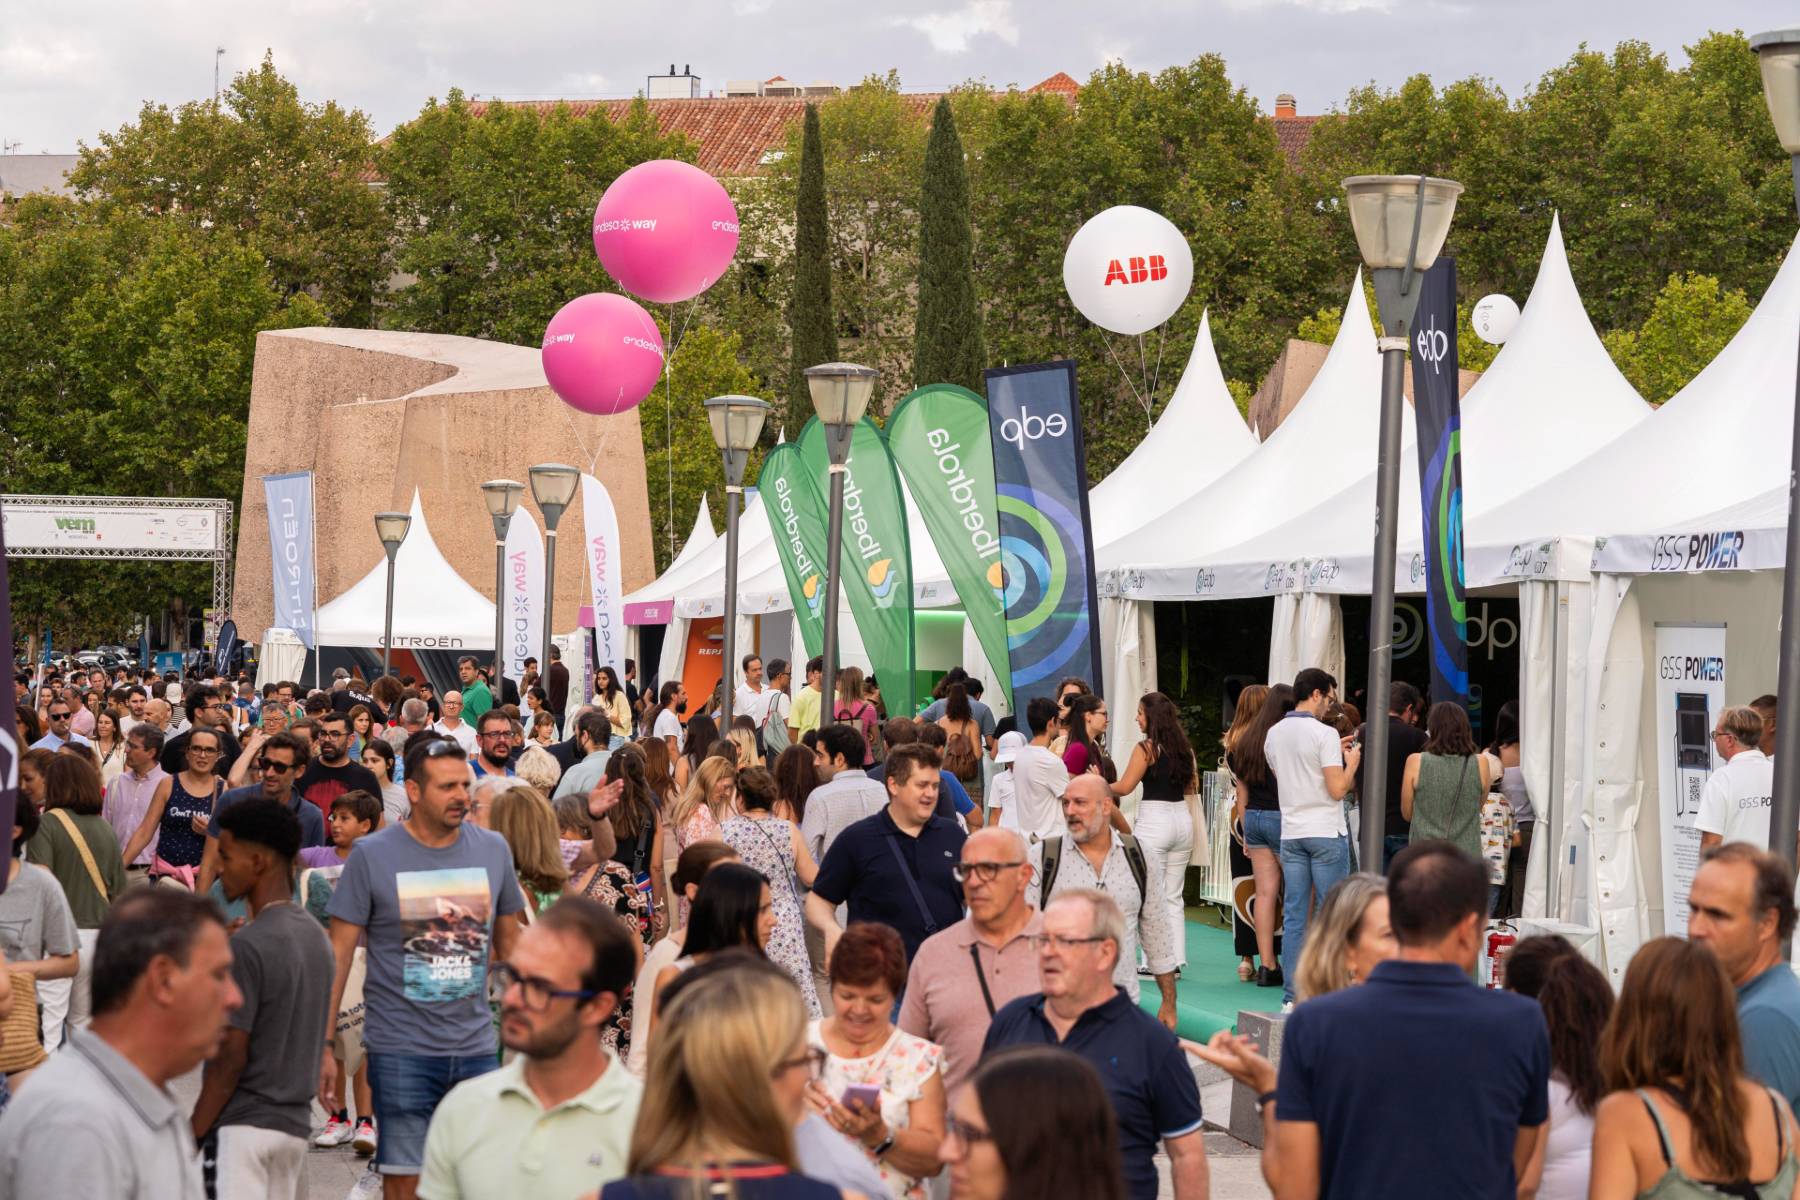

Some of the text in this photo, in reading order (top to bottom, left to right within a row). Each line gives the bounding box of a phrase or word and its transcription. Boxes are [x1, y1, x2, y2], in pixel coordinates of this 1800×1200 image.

[632, 219, 657, 232] way
[1104, 255, 1168, 285] ABB
[556, 333, 576, 343] way
[1417, 314, 1448, 375] edp
[55, 518, 96, 531] vem
[1652, 531, 1744, 571] GSS POWER
[1466, 603, 1517, 660] dp
[378, 636, 463, 647] CITROËN
[1661, 656, 1723, 681] GSS POWER
[1739, 797, 1759, 809] GSS
[431, 955, 463, 968] JACK
[430, 967, 473, 980] JONES
